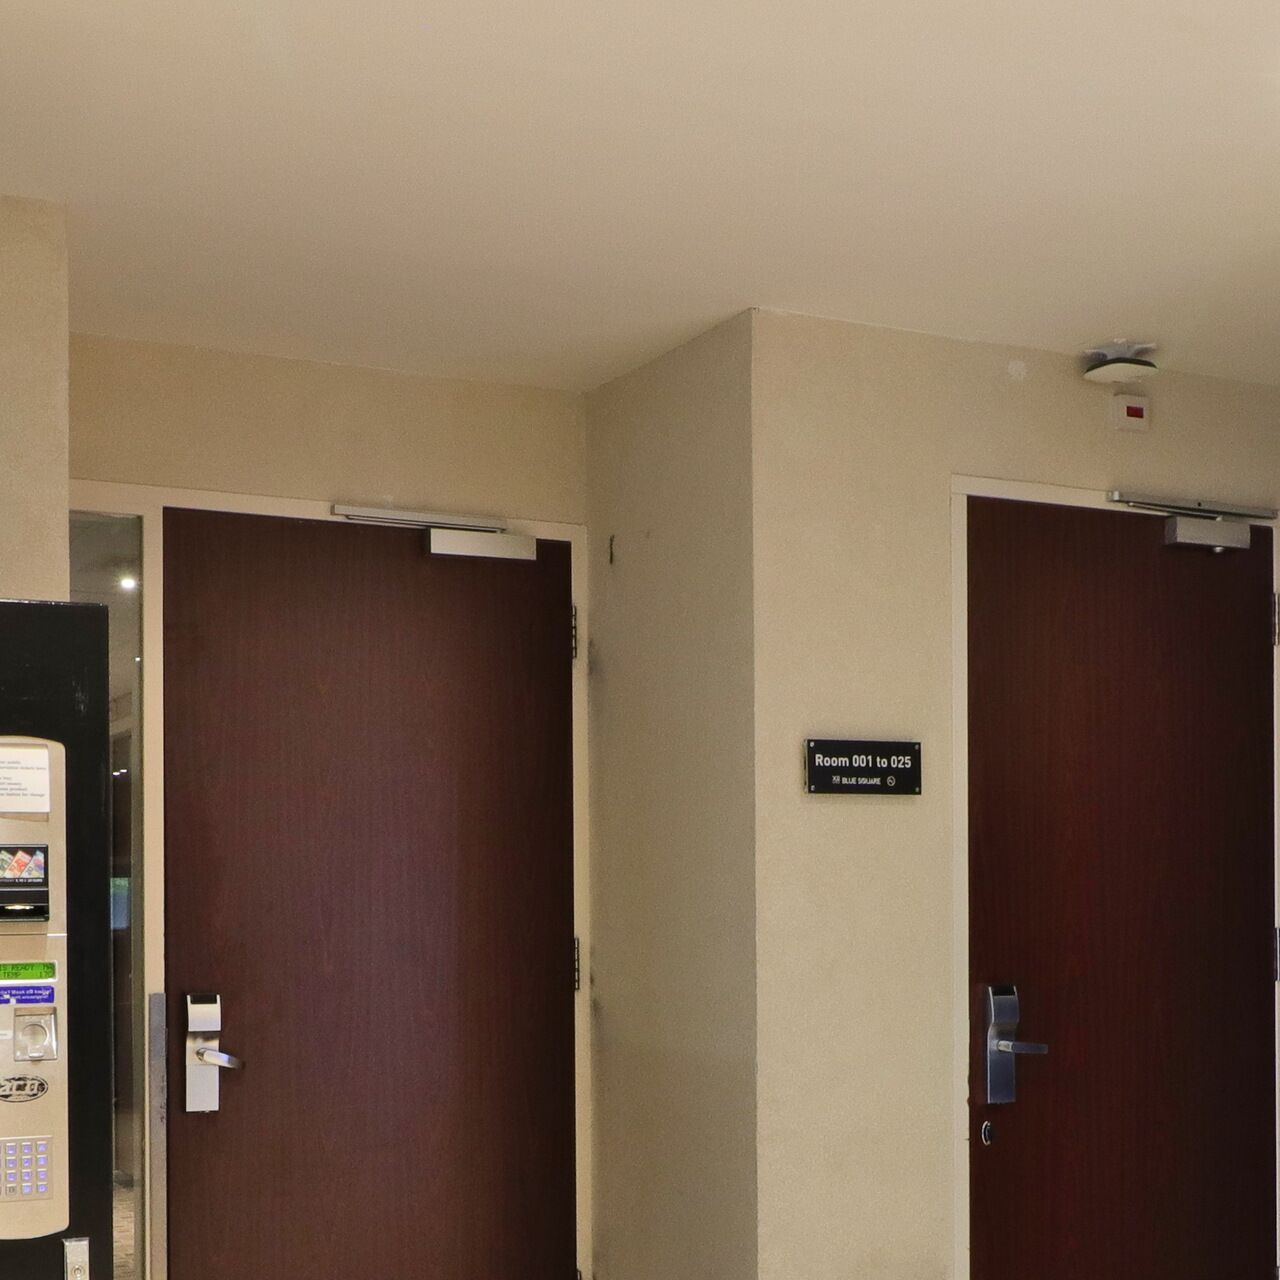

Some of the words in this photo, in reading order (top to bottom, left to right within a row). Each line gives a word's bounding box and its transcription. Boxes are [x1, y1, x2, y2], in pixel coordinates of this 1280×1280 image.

[815, 754, 849, 766] Room
[852, 755, 872, 767] 001
[876, 756, 888, 768] to
[891, 756, 912, 768] 025
